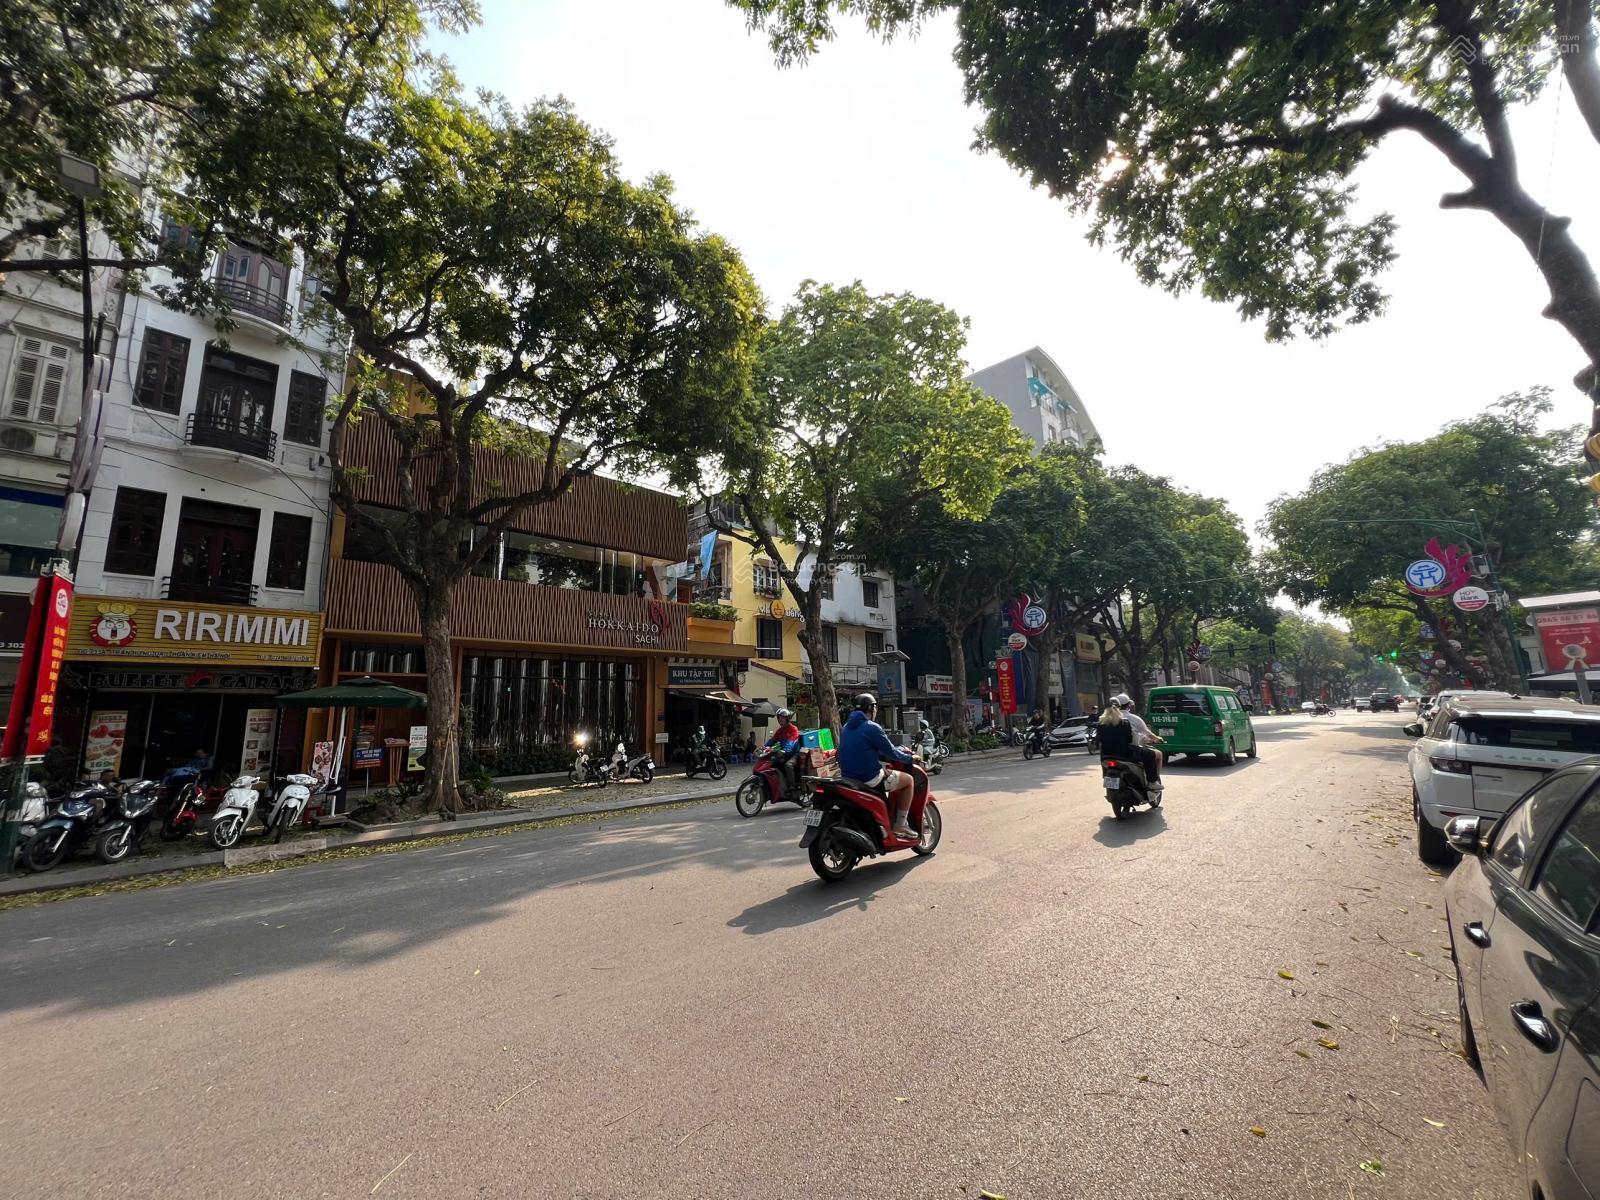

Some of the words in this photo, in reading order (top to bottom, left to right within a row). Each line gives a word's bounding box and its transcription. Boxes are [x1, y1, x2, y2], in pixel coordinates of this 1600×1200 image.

[153, 609, 310, 646] RIRIMIMI
[588, 618, 659, 634] HOKKAIDO
[635, 634, 659, 644] SACHI
[672, 670, 688, 678] KHU
[689, 668, 701, 679] TẬP
